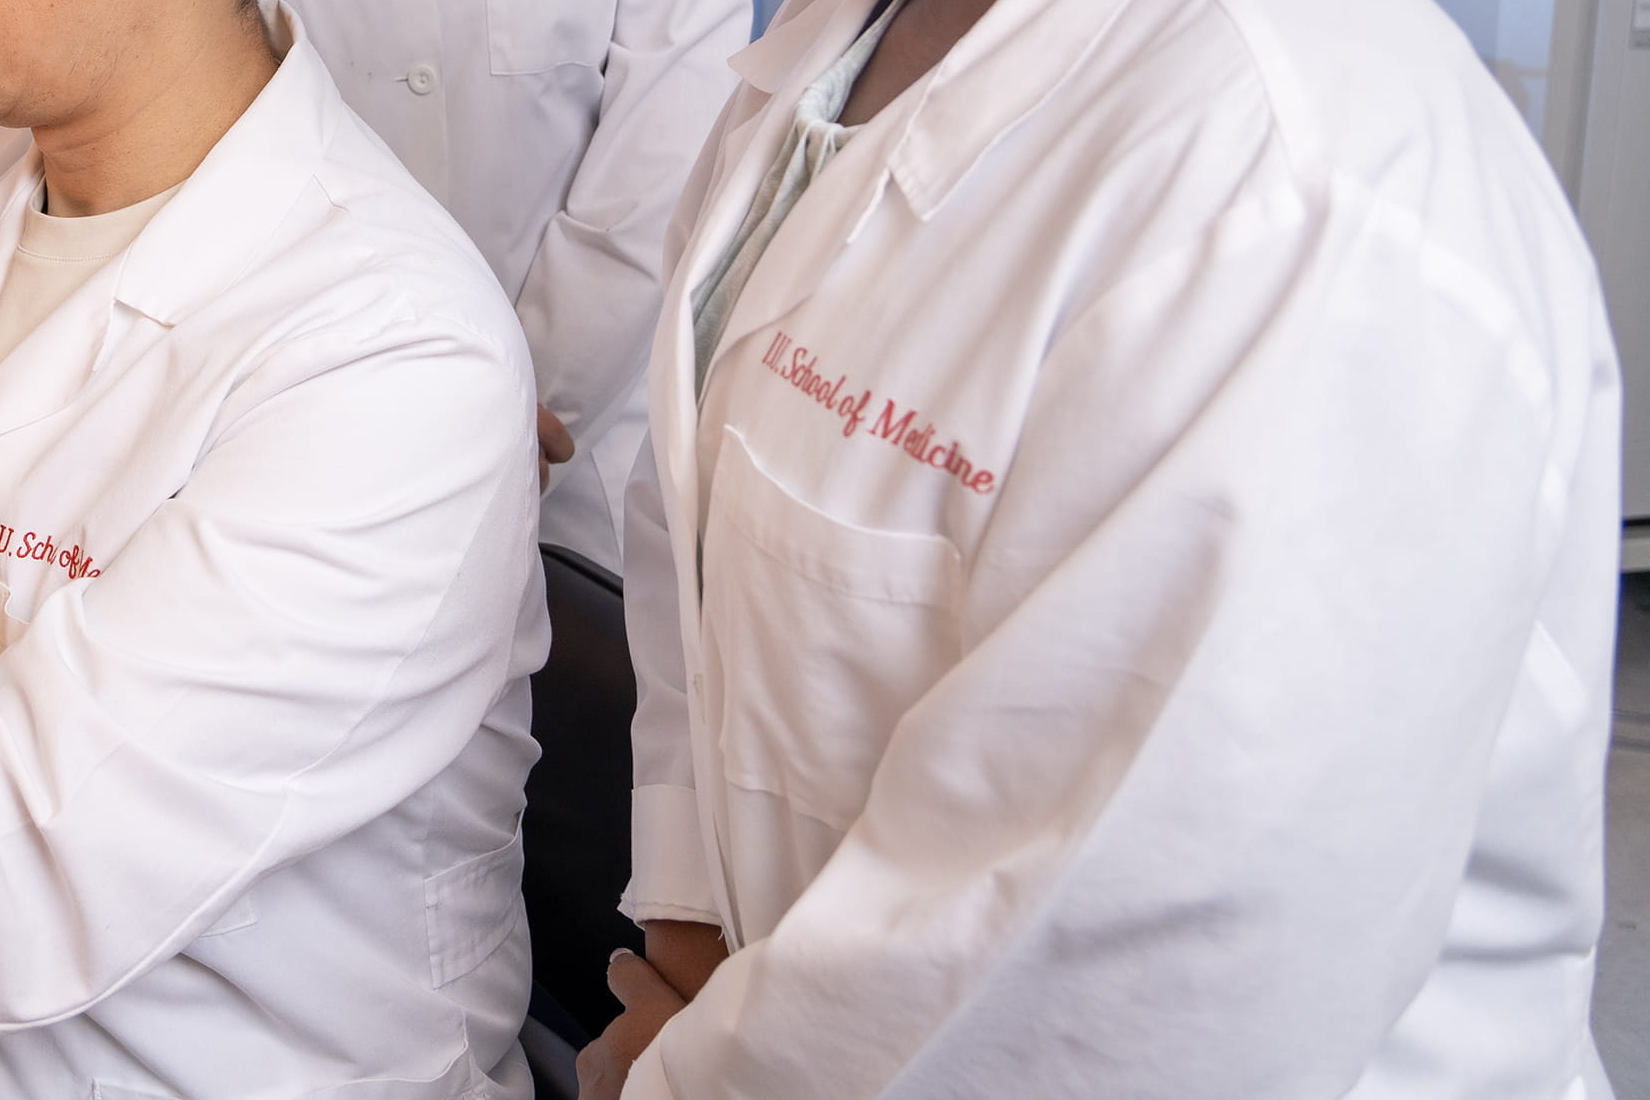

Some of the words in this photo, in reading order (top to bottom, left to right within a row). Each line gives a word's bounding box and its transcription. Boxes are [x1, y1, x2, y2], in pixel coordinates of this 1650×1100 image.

[781, 346, 847, 411] School
[837, 389, 872, 438] of
[58, 544, 80, 580] of
